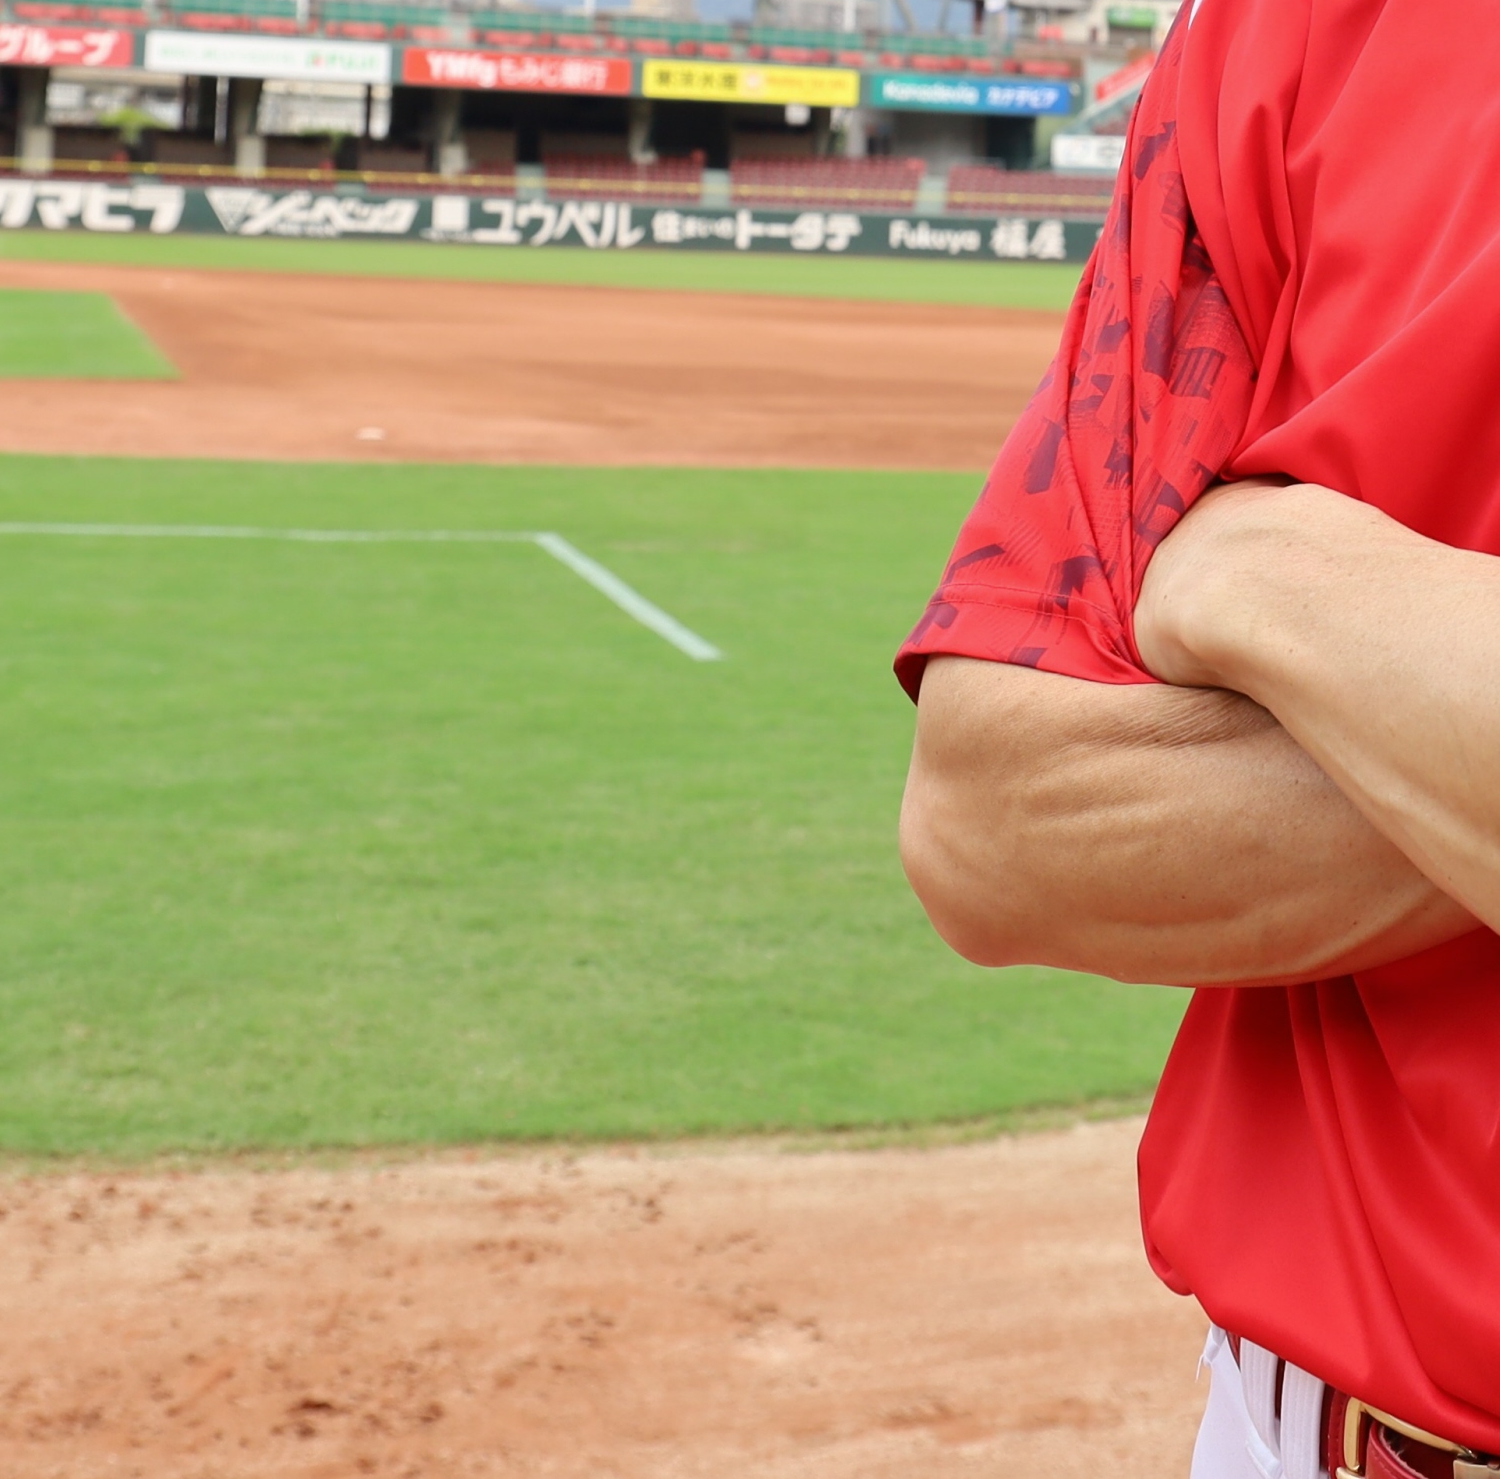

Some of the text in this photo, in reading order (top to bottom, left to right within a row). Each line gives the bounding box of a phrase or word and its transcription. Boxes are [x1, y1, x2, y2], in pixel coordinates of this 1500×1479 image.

[473, 198, 645, 248] ユウベル
[889, 219, 980, 255] Fukuya
